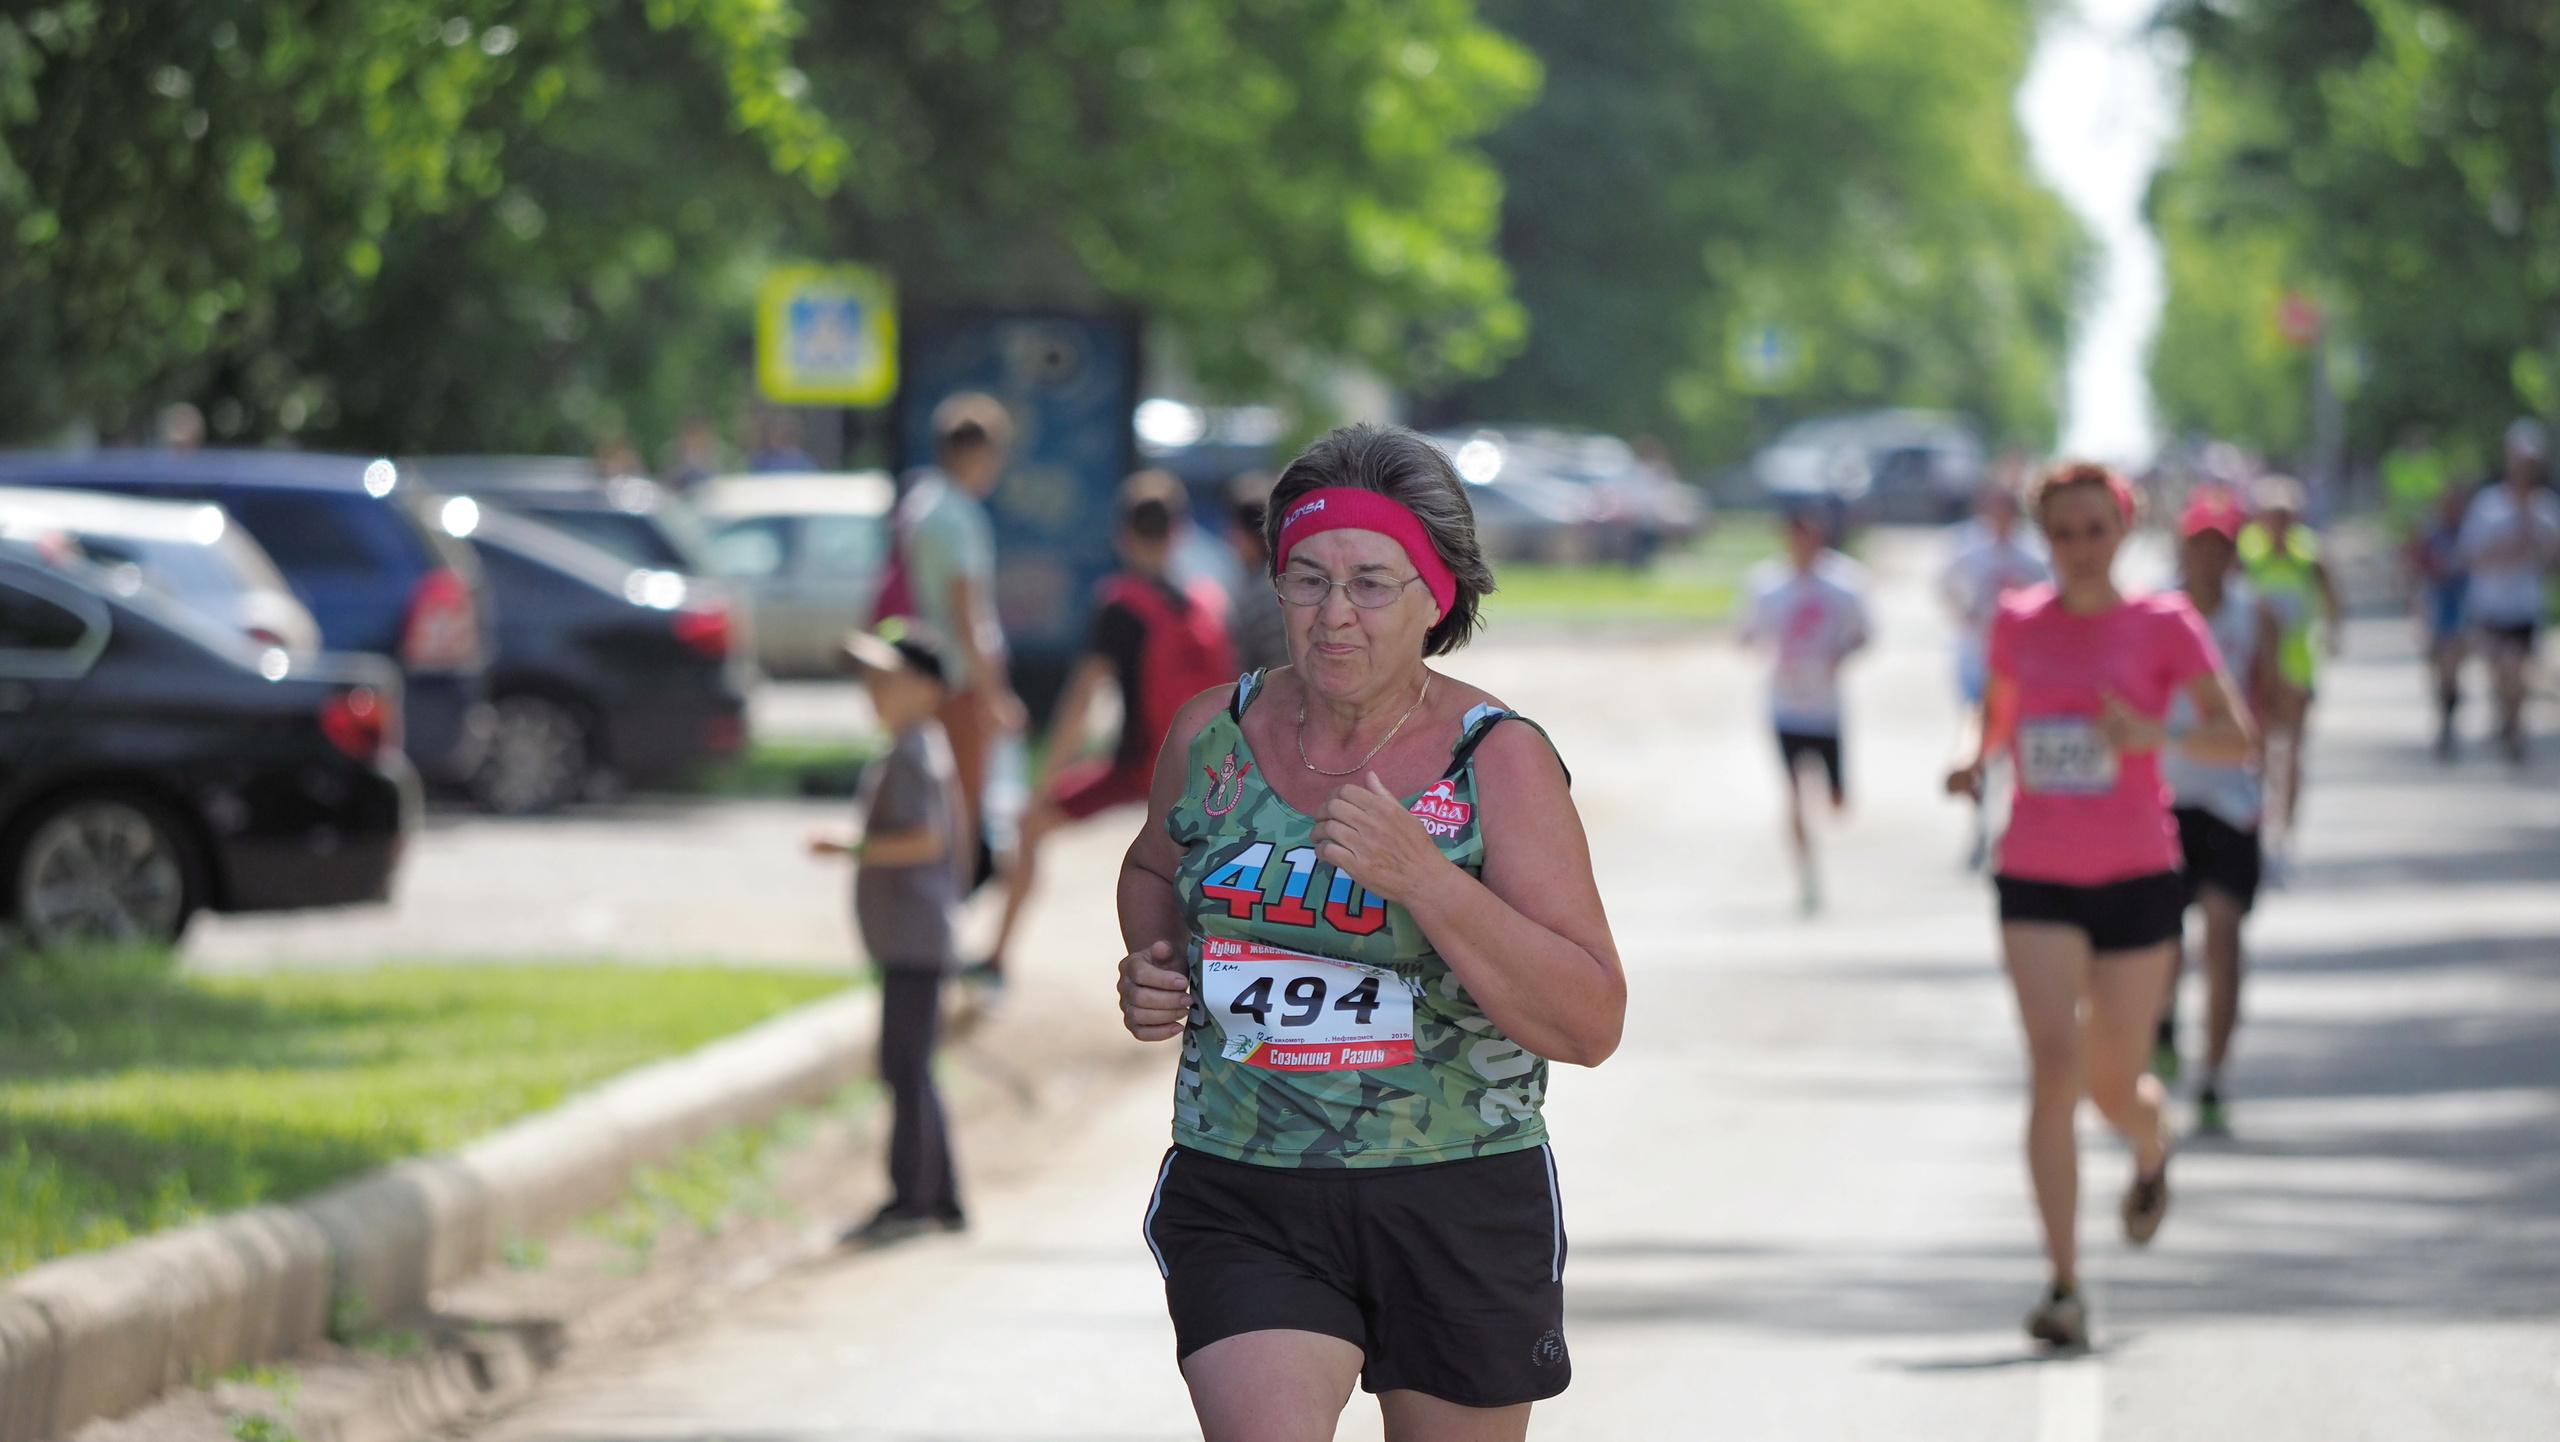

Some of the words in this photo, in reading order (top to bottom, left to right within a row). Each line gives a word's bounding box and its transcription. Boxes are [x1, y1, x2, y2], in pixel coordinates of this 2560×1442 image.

[1201, 841, 1387, 936] 410
[1230, 977, 1380, 1026] 494
[1332, 1034, 1374, 1043] Нефтекамск
[1270, 1049, 1332, 1067] Созыкина
